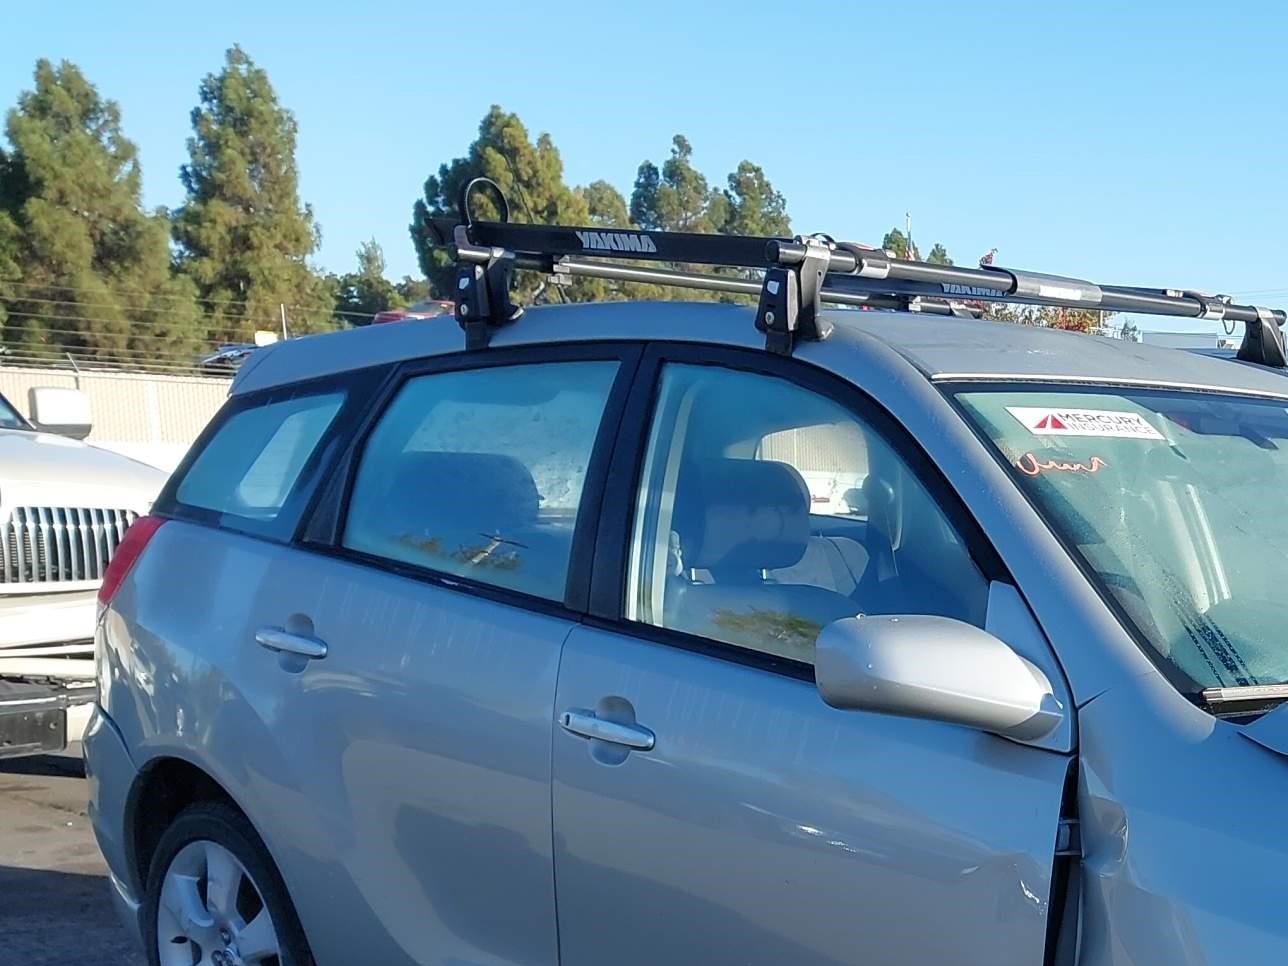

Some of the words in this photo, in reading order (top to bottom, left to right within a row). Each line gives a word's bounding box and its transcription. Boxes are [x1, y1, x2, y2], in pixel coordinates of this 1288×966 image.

[575, 230, 657, 253] YAKIMA
[1057, 412, 1143, 426] MERCURY
[1066, 422, 1156, 435] INSURANCE
